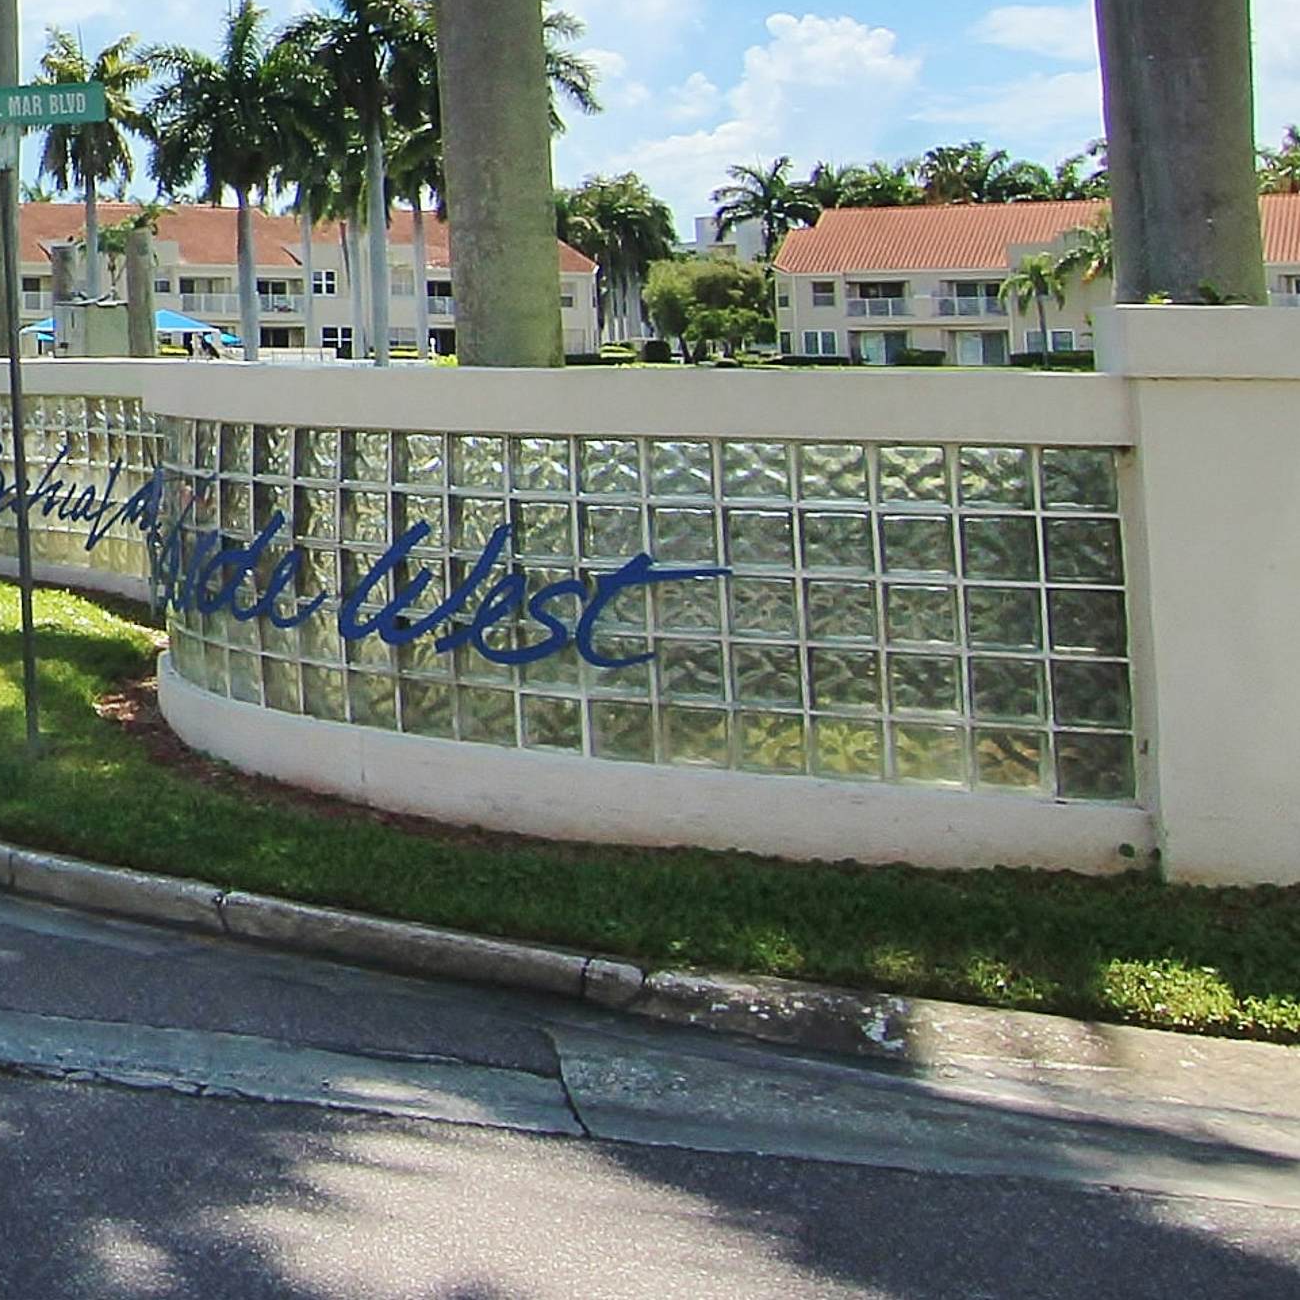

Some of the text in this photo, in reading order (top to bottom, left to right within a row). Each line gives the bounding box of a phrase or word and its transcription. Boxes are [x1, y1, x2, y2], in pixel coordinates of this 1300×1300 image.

[8, 95, 43, 116] MAR
[50, 93, 86, 114] BLVD
[338, 519, 732, 668] West
